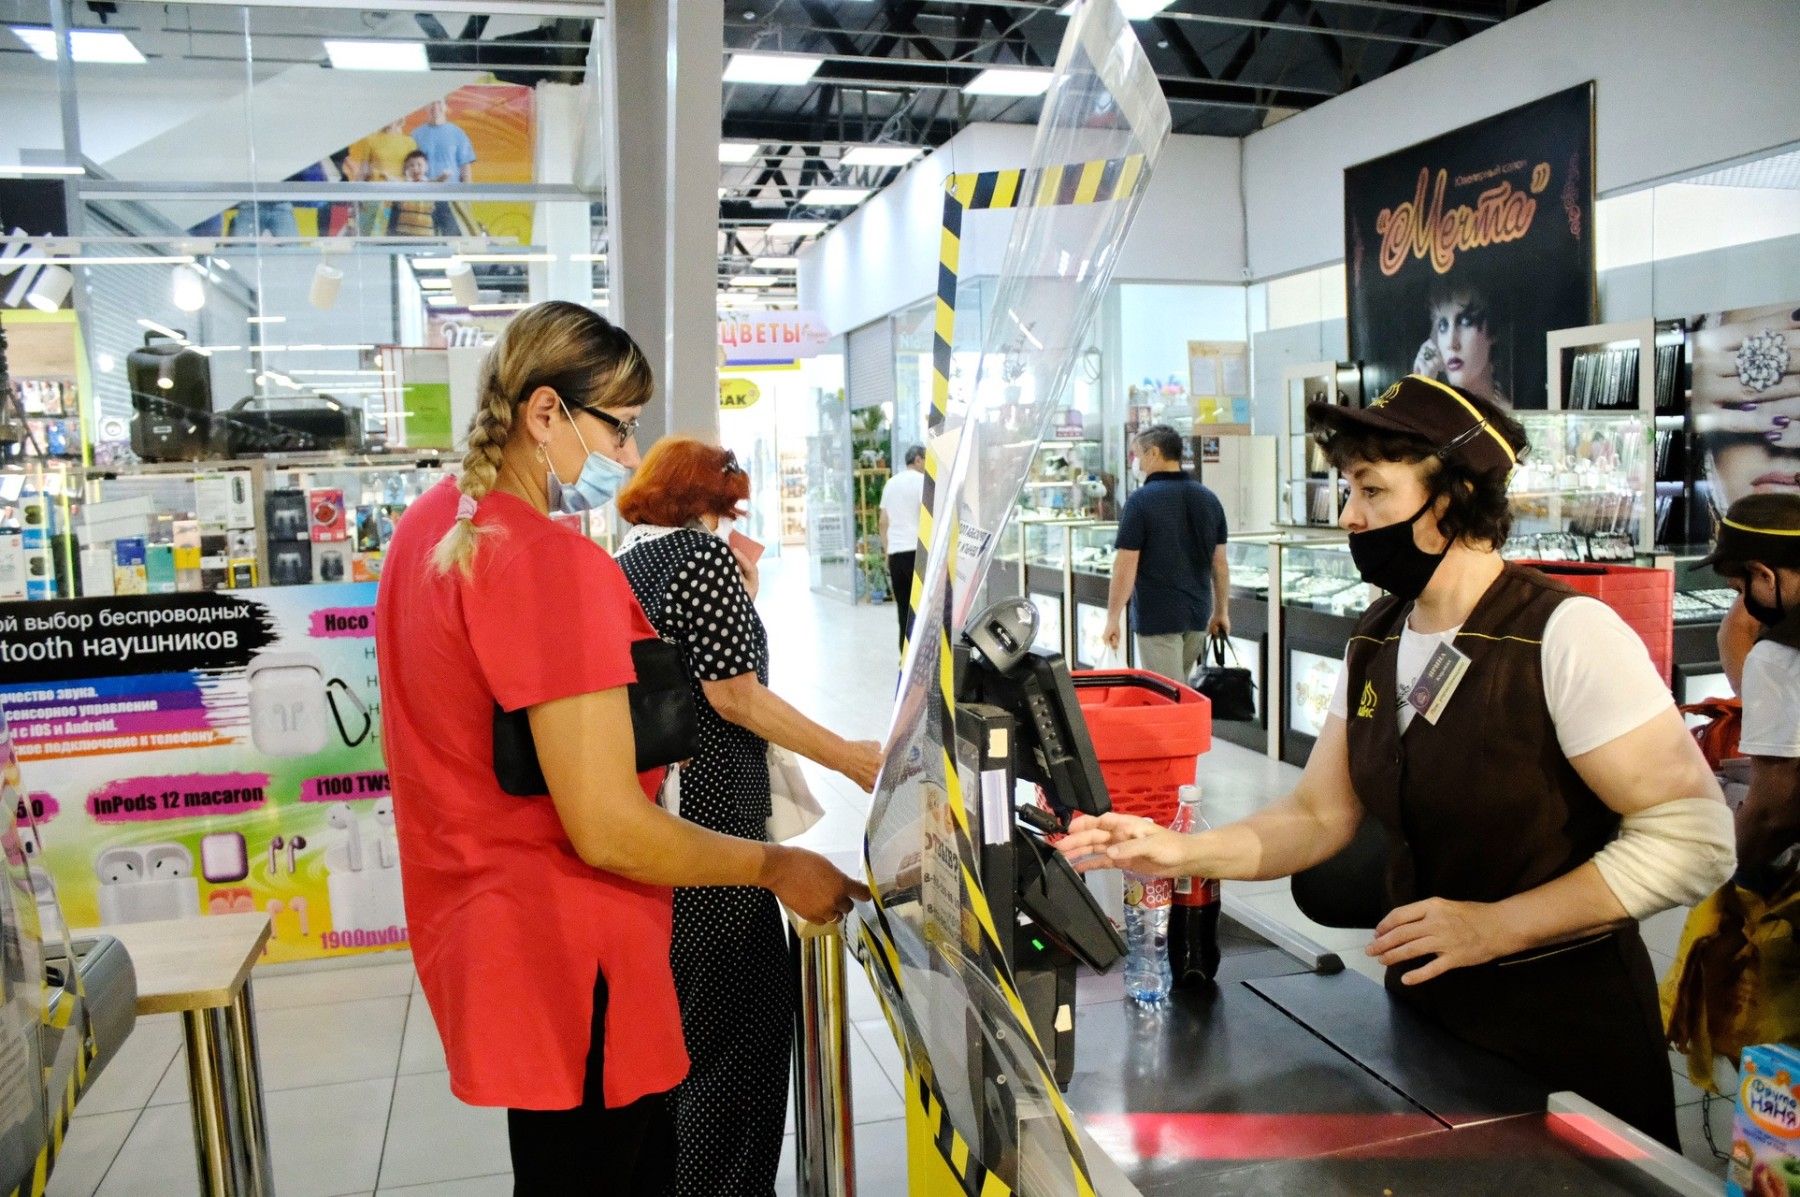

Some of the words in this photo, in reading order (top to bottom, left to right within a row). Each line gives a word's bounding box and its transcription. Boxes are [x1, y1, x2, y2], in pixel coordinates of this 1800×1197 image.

[720, 321, 801, 348] ЦВЕТЫ
[24, 611, 93, 632] выбор
[99, 605, 250, 627] беспроводных
[1, 634, 73, 663] tooth
[82, 629, 238, 661] наушников
[78, 699, 158, 717] управление
[159, 791, 180, 810] 12
[183, 786, 264, 808] macaron
